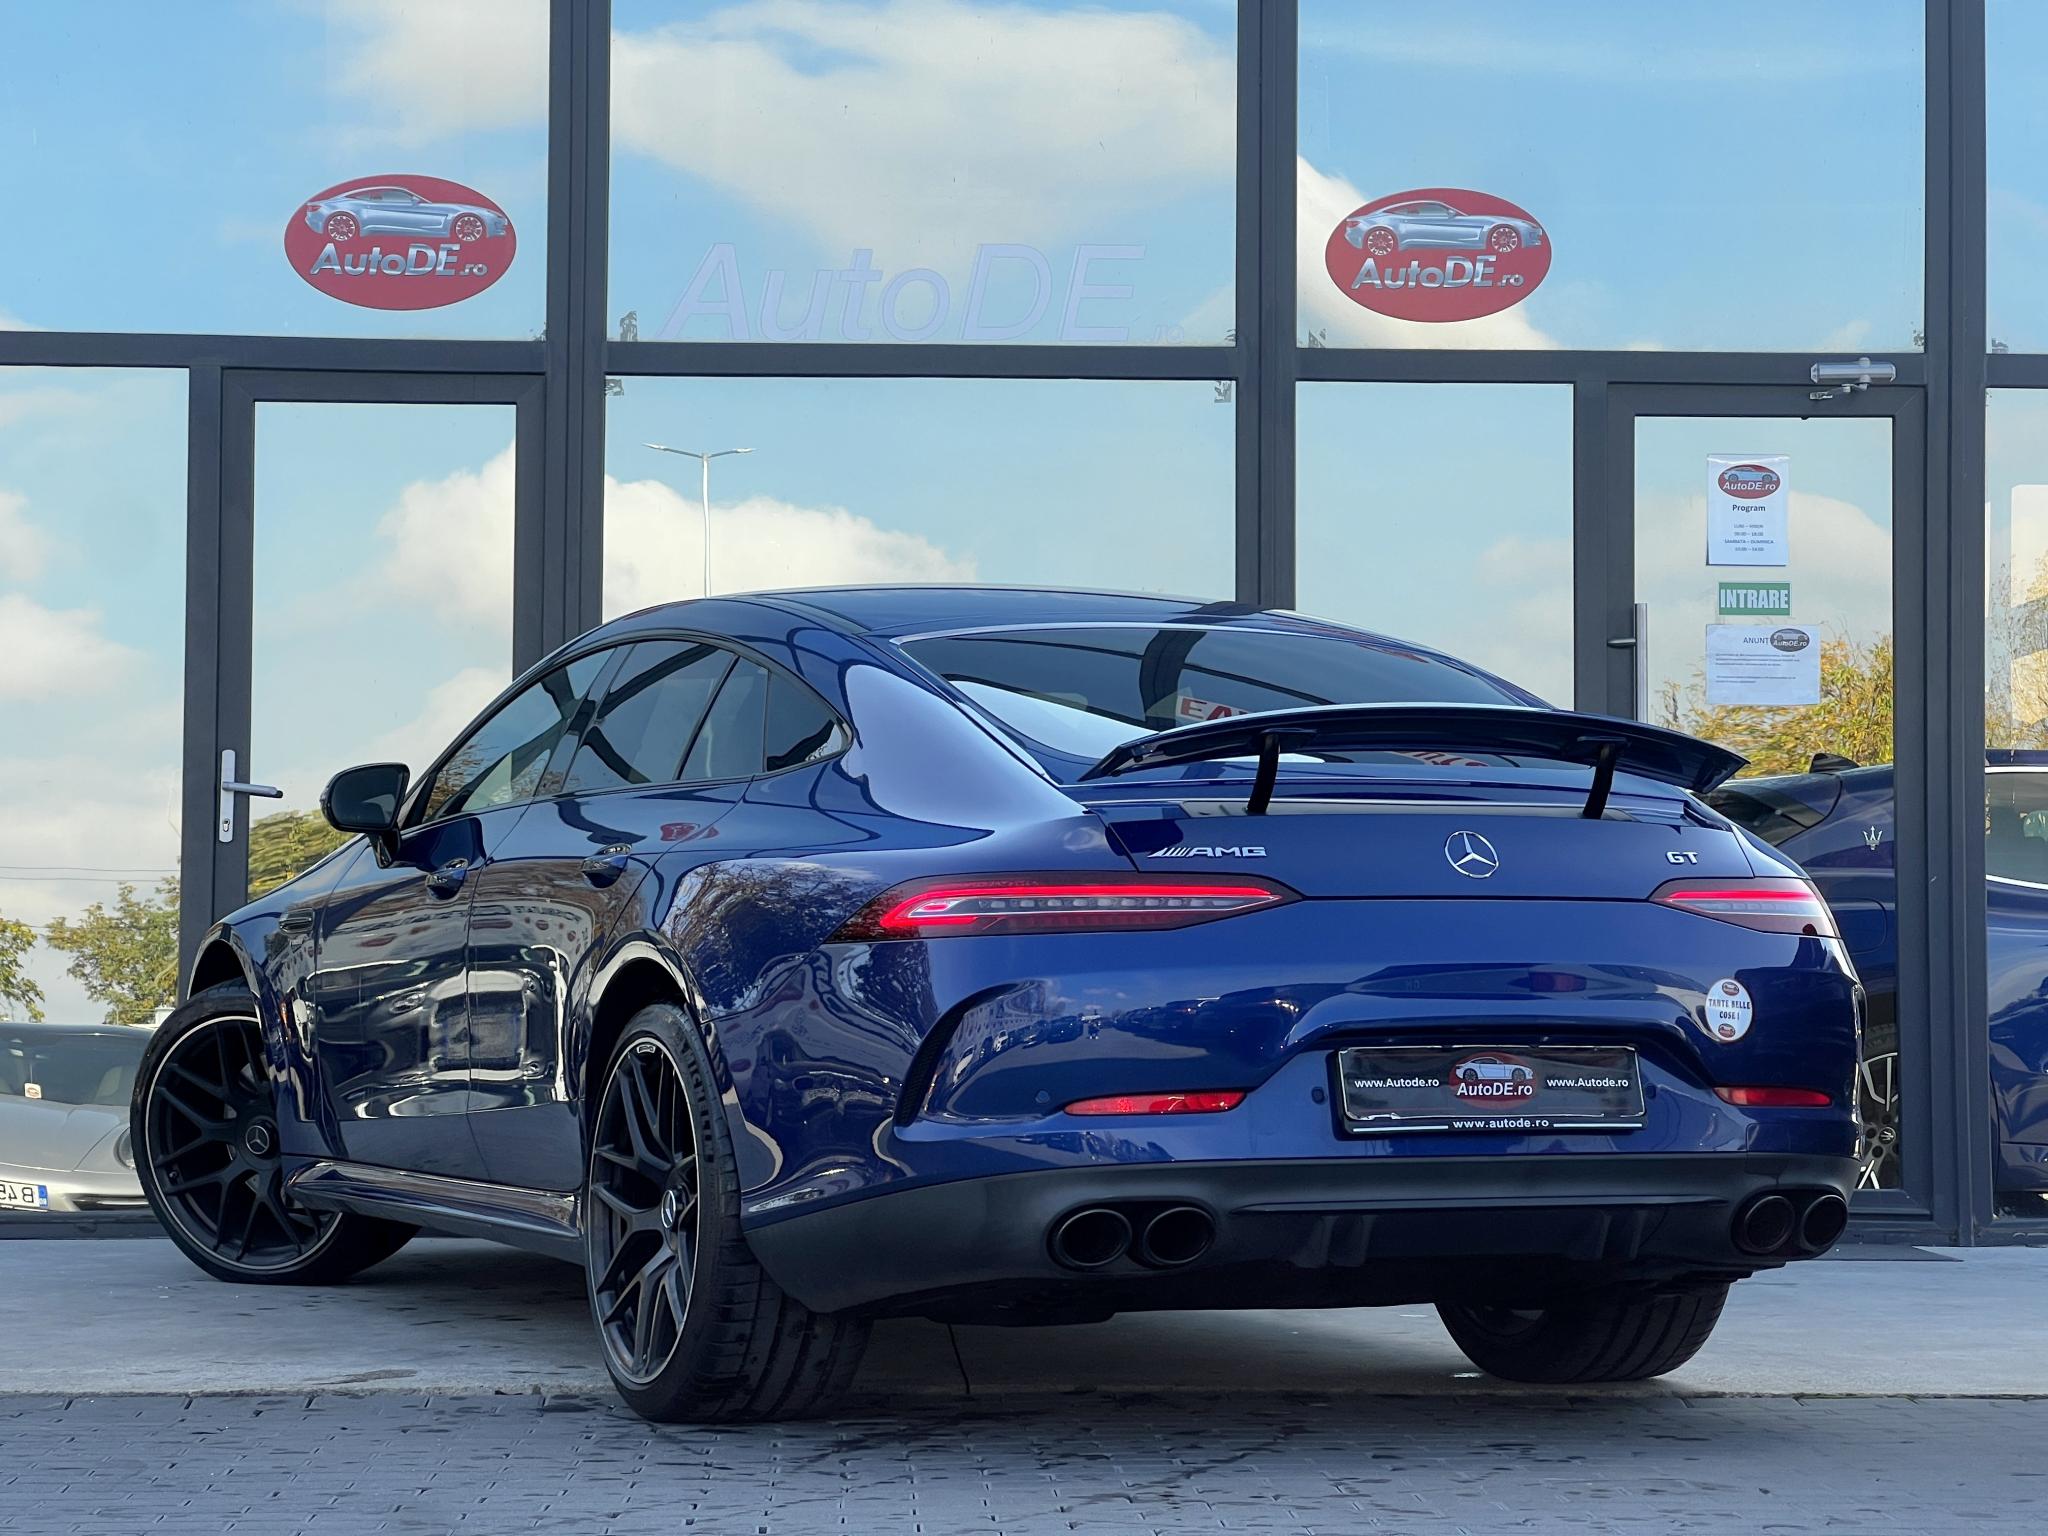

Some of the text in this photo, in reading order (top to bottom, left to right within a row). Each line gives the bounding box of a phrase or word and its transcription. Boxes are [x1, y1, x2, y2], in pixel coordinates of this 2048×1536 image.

[1722, 481, 1776, 490] AutoDE.ro
[1732, 504, 1766, 512] Program
[1720, 589, 1789, 608] INTRARE
[1185, 846, 1267, 858] AMG
[1666, 851, 1698, 864] GT
[1731, 1000, 1751, 1009] BELLE
[1719, 1011, 1736, 1020] COSE
[1354, 1078, 1440, 1088] www.Autode.ro
[1547, 1078, 1629, 1087] www.Autode.ro
[1456, 1082, 1533, 1096] AutoDE.ro
[1452, 1118, 1550, 1129] www.autode.ro
